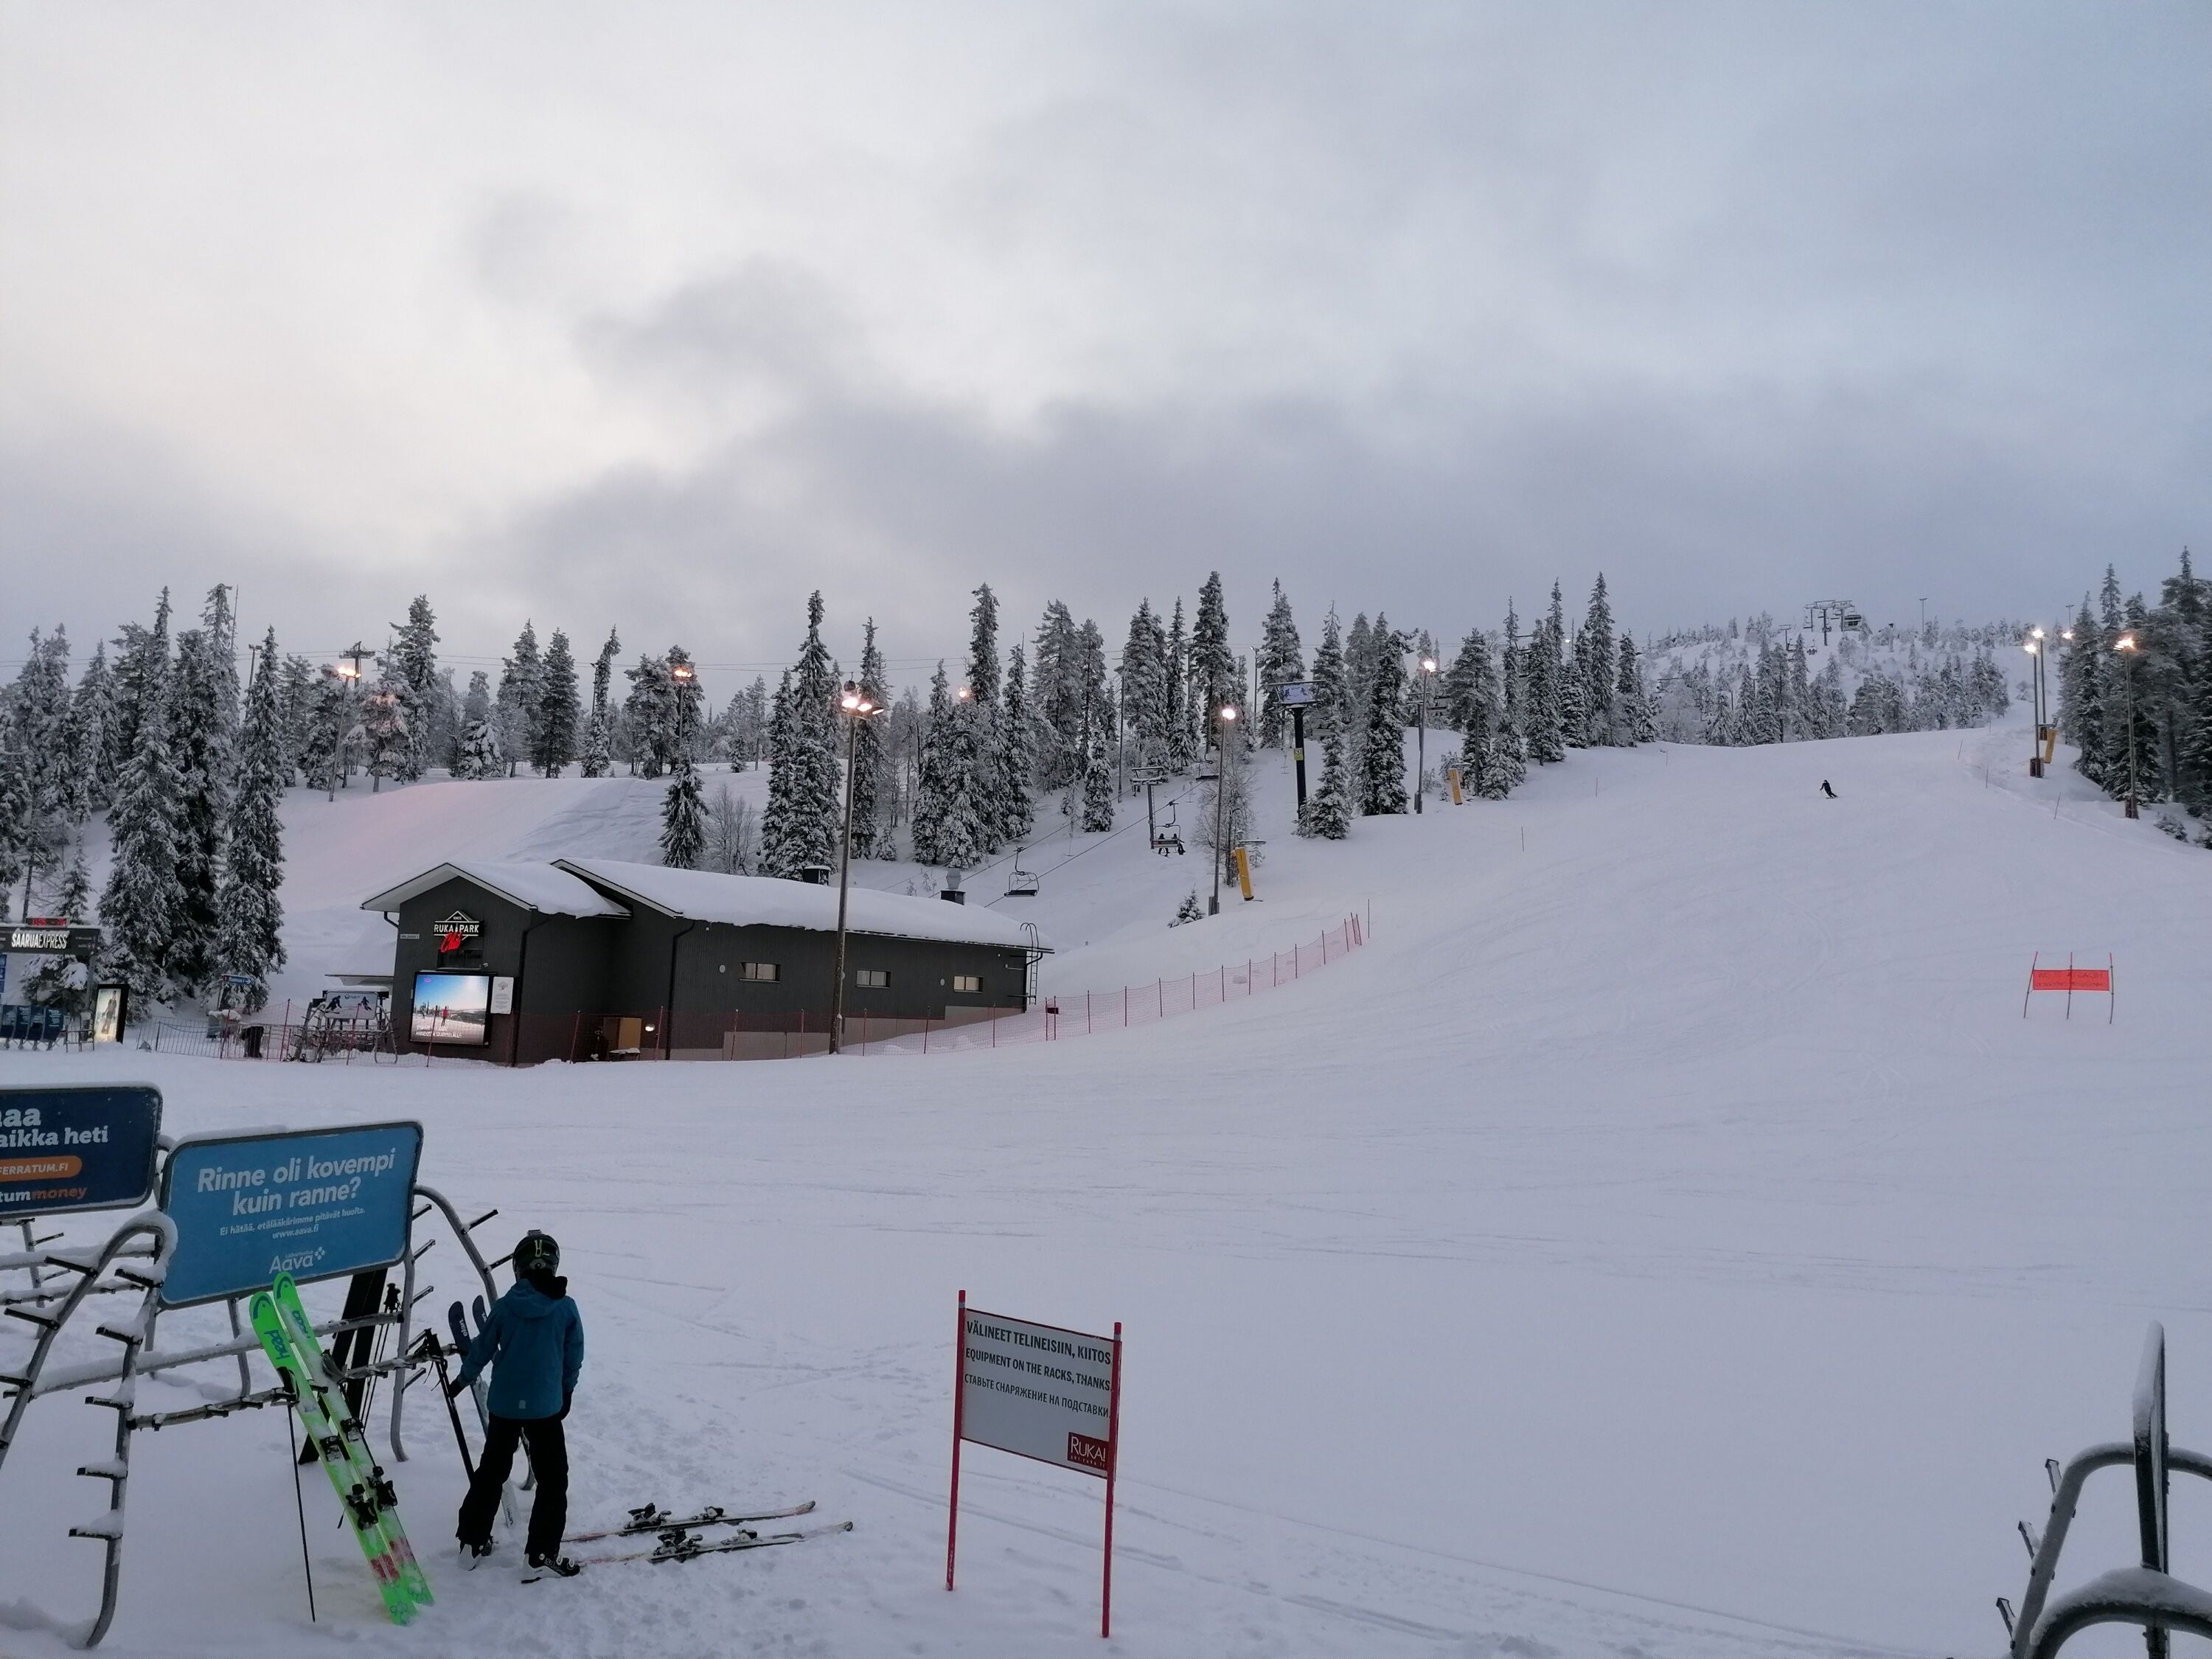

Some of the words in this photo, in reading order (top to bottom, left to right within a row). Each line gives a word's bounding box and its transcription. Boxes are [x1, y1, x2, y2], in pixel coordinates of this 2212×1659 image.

[434, 924, 454, 933] RUKA
[459, 925, 479, 933] PARK
[0, 1108, 41, 1127] aa
[64, 1125, 108, 1144] heti
[198, 1166, 265, 1192] Rinne
[274, 1158, 301, 1183] oli
[307, 1147, 395, 1177] kovempi
[233, 1188, 282, 1215] kuin
[289, 1176, 361, 1208] ranne?
[220, 1227, 228, 1236] Ei
[315, 1210, 341, 1223] pitävät
[272, 1224, 319, 1239] www.aava.fi
[269, 1254, 313, 1274] Aava
[967, 1320, 1012, 1343] VÄLINEET
[1014, 1332, 1075, 1358] TELINEISIIN,
[1078, 1346, 1111, 1365] KIITOS
[966, 1348, 1011, 1368] EQUIPMENT
[1012, 1360, 1024, 1371] ON
[1026, 1361, 1042, 1375] THE
[1044, 1367, 1074, 1385] RACKS,
[964, 1374, 994, 1389] СТАВЬТЕ
[995, 1381, 1048, 1402] СНАРЯЖЕНИЕ
[1048, 1394, 1060, 1405] НА
[1071, 1436, 1105, 1461] RUKA!
